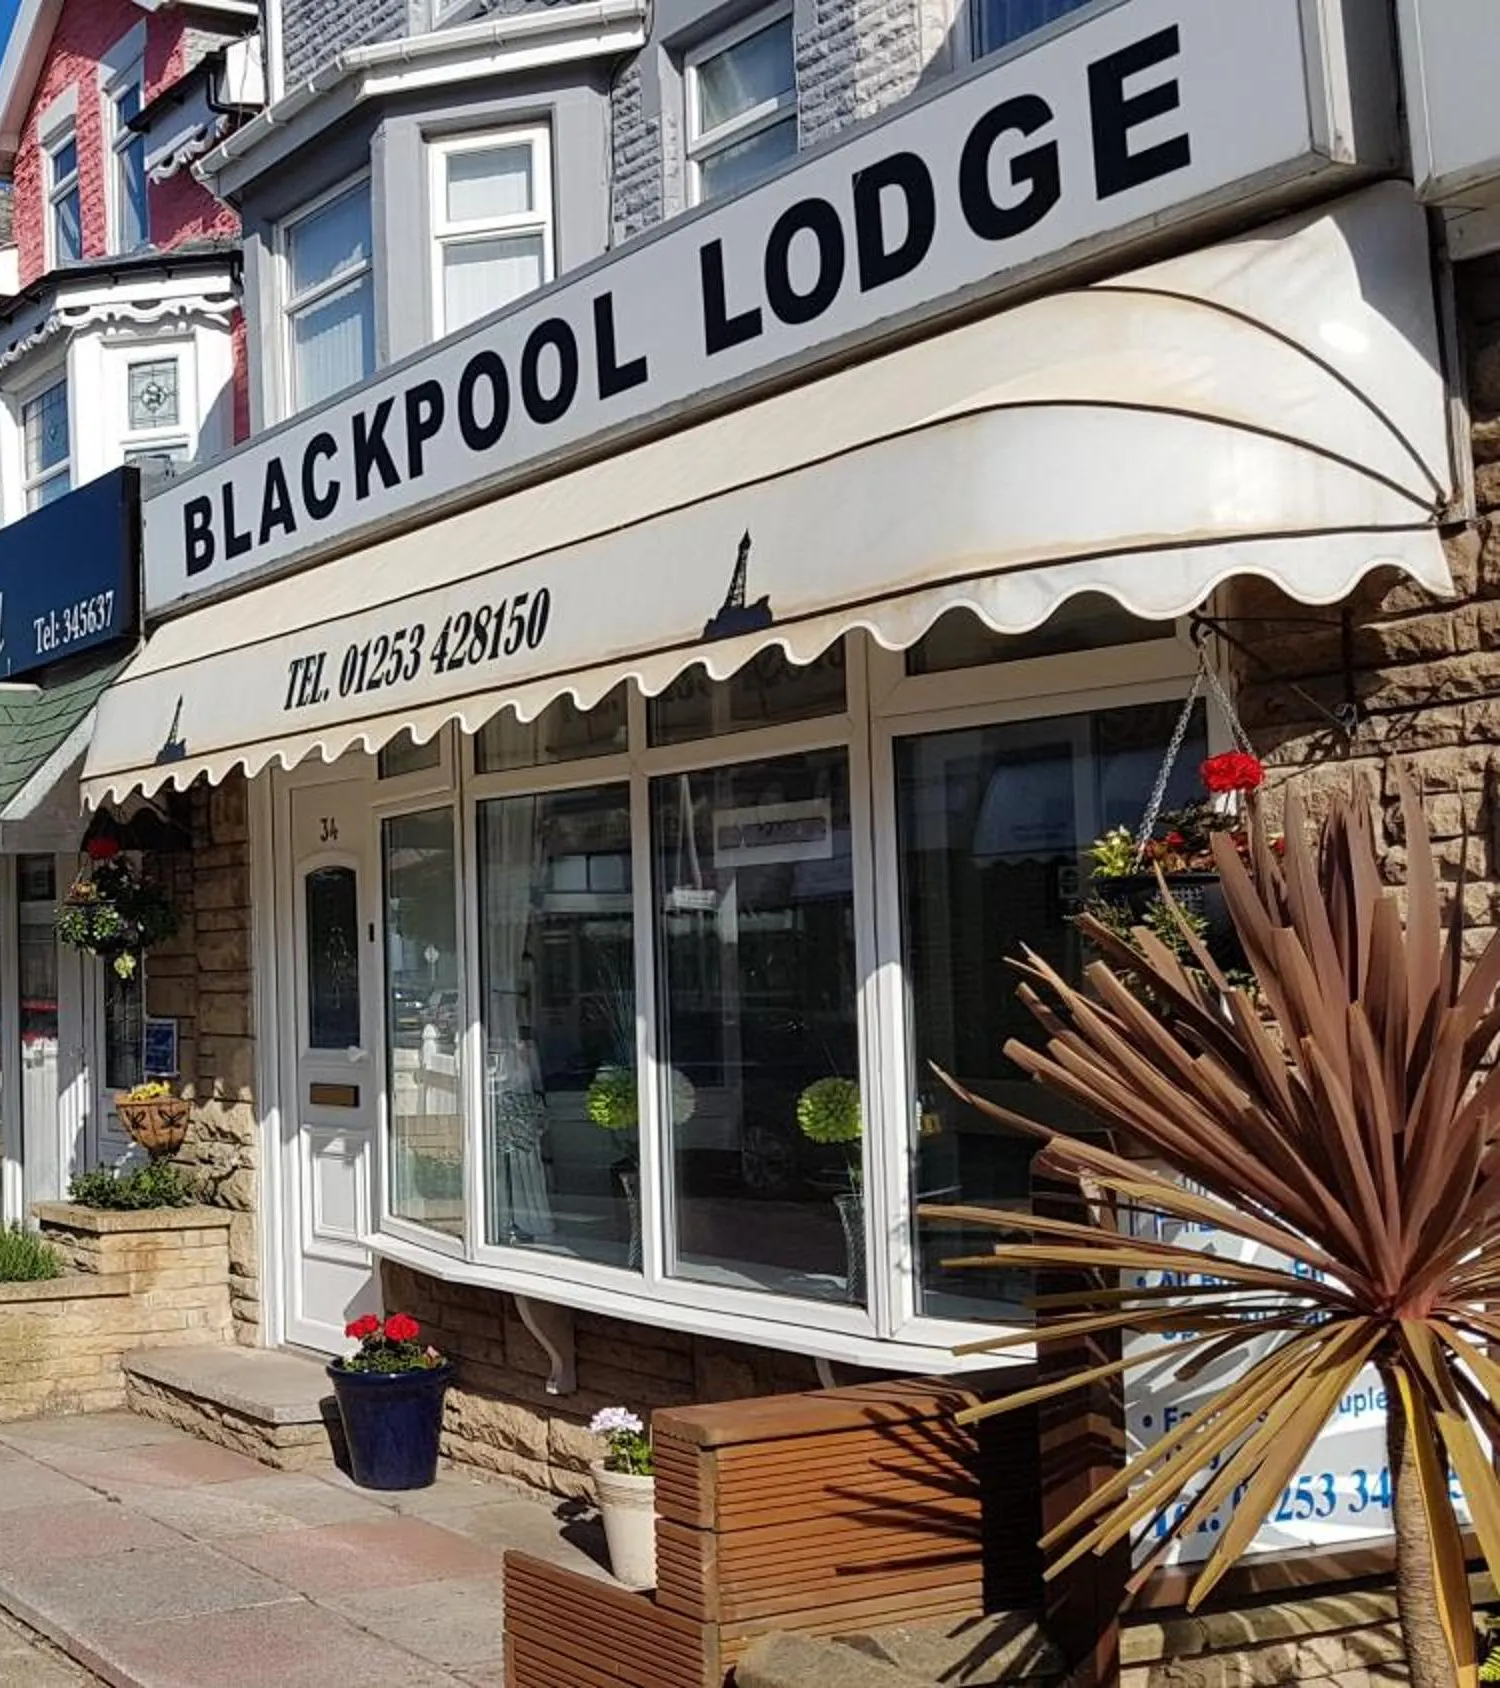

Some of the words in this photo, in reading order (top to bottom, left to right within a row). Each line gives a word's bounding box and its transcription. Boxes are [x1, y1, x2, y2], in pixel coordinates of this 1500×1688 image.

[184, 292, 649, 577] BLACKPOOL
[699, 24, 1192, 356] LODGE
[33, 608, 60, 654] Tel:
[62, 589, 115, 643] 345637
[283, 651, 330, 711] TEL.
[338, 623, 425, 698] 01253
[429, 587, 551, 676] 428150
[319, 817, 339, 842] 34
